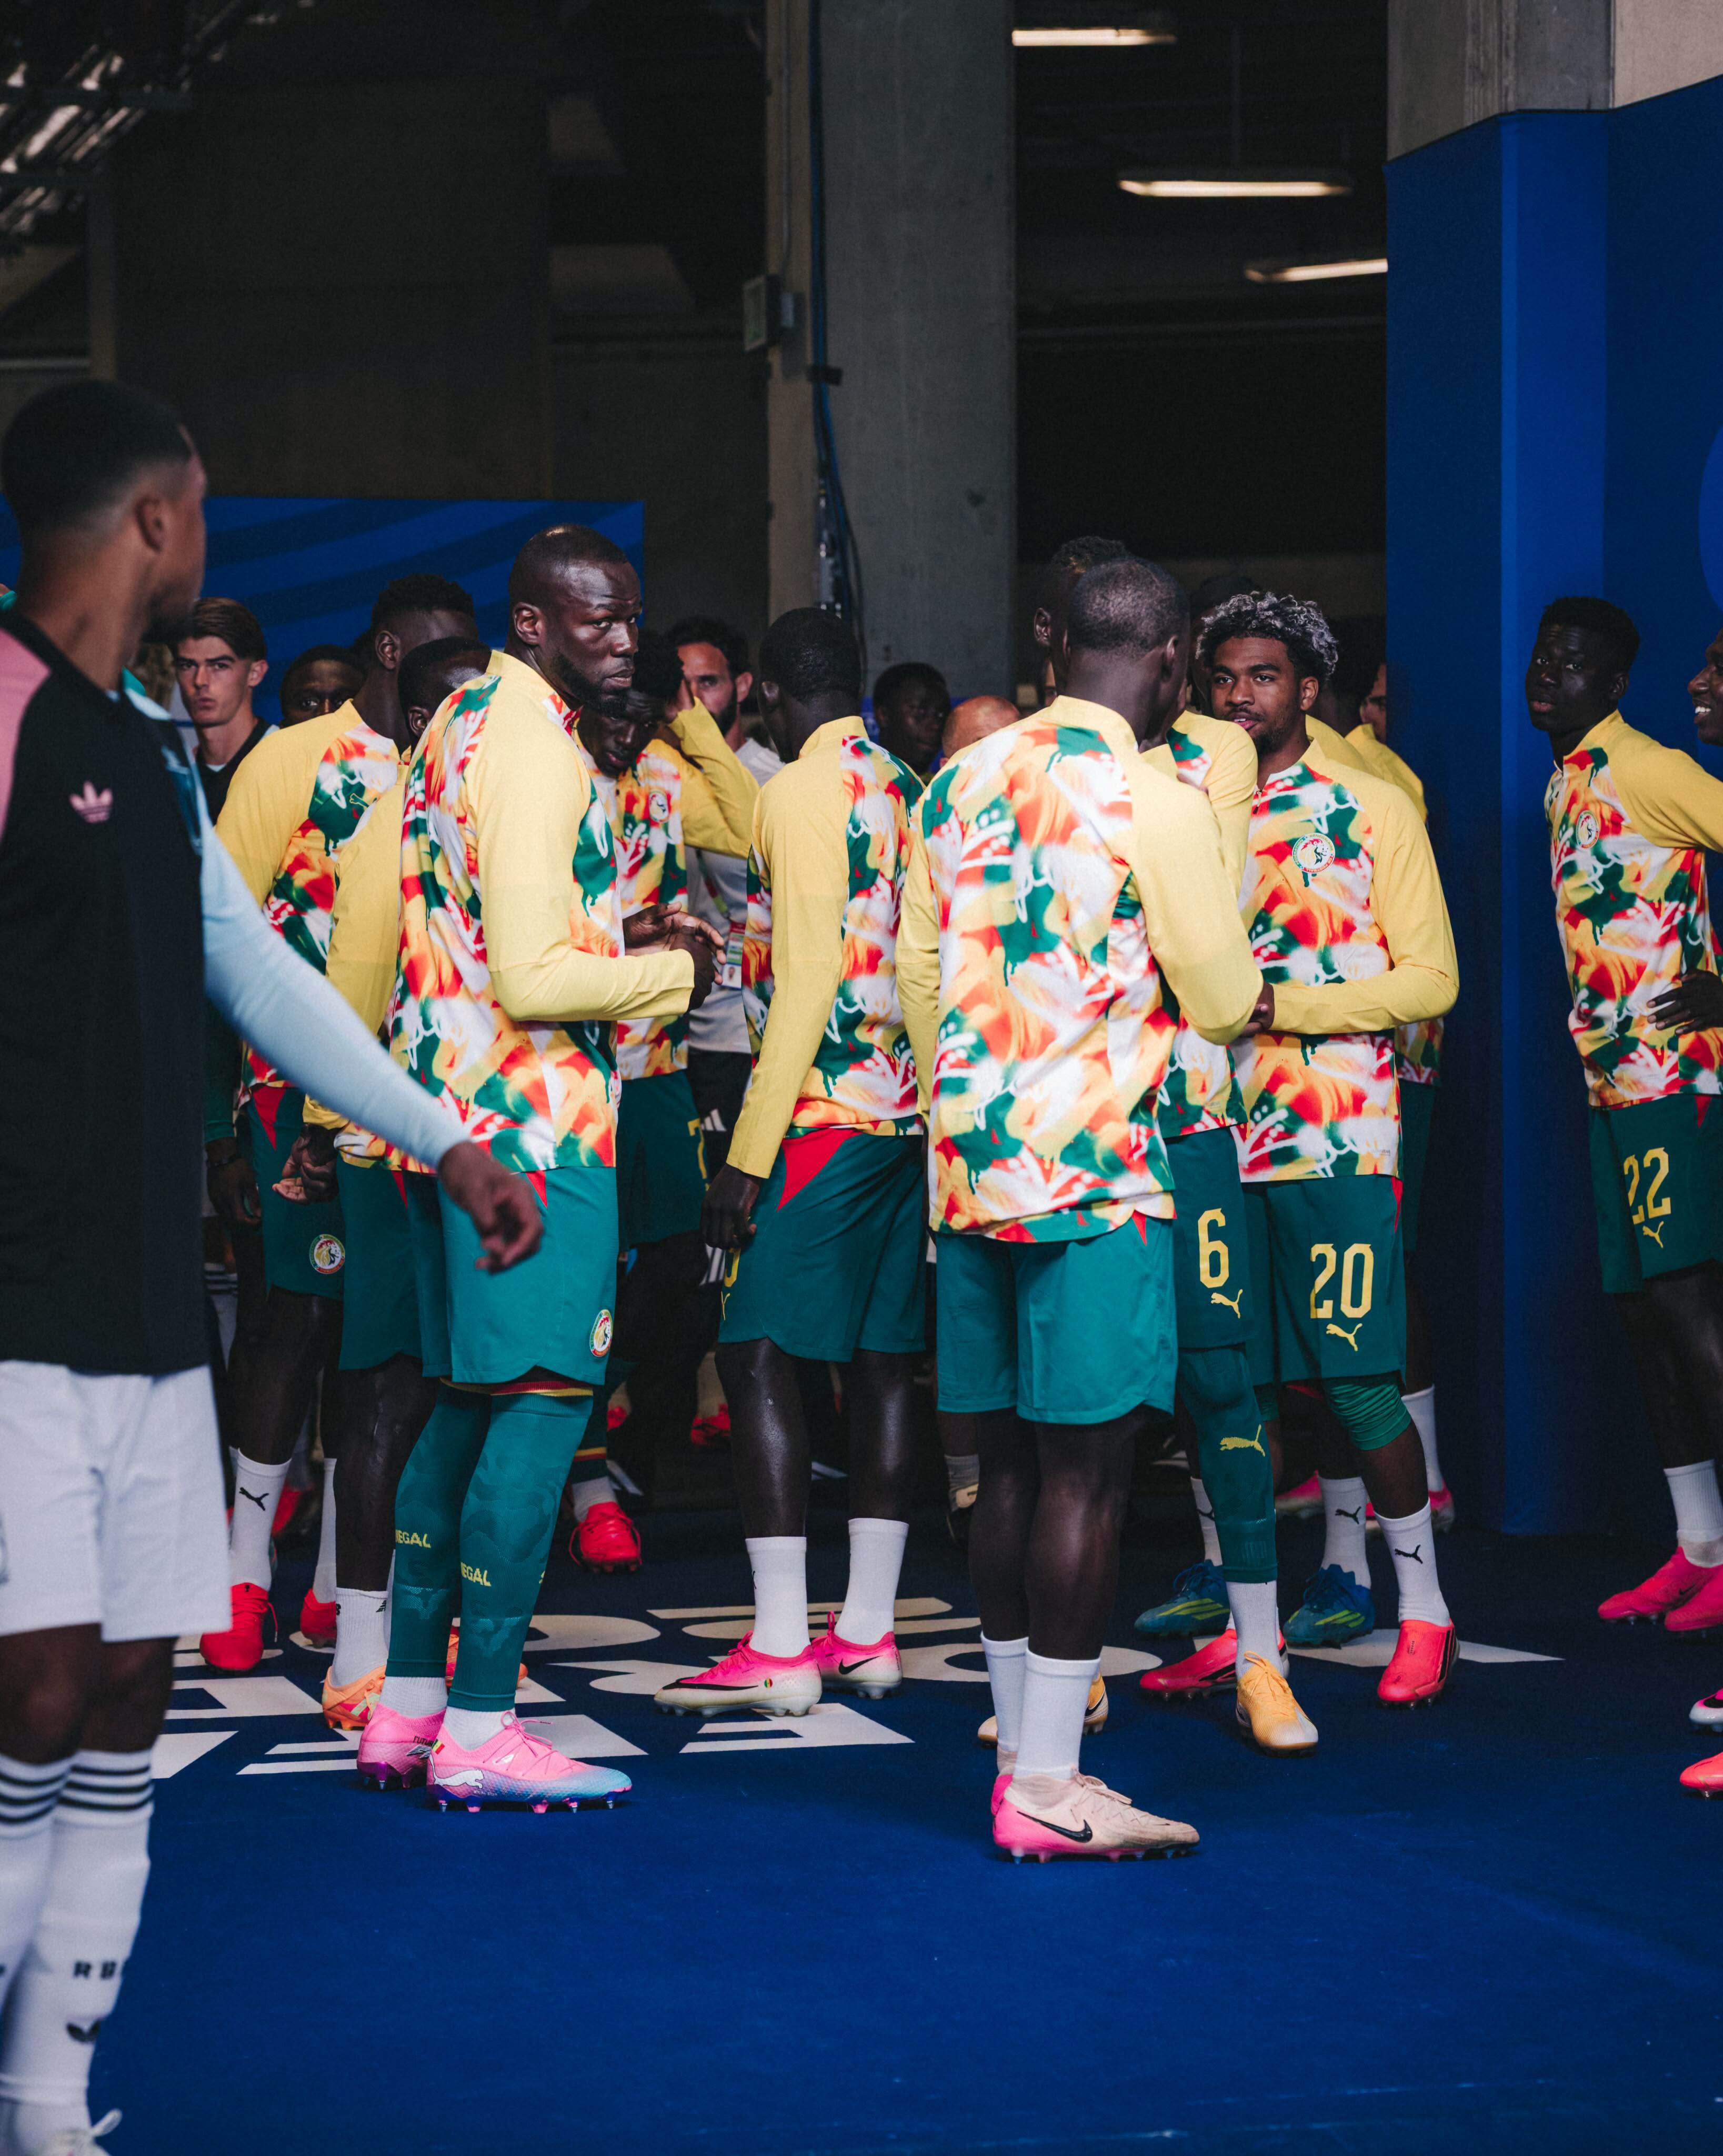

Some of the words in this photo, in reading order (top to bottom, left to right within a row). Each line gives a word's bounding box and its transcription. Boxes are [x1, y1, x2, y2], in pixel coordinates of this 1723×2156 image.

[1623, 1147, 1671, 1224] 22
[1198, 1207, 1229, 1288] 6
[1310, 1243, 1375, 1319] 20
